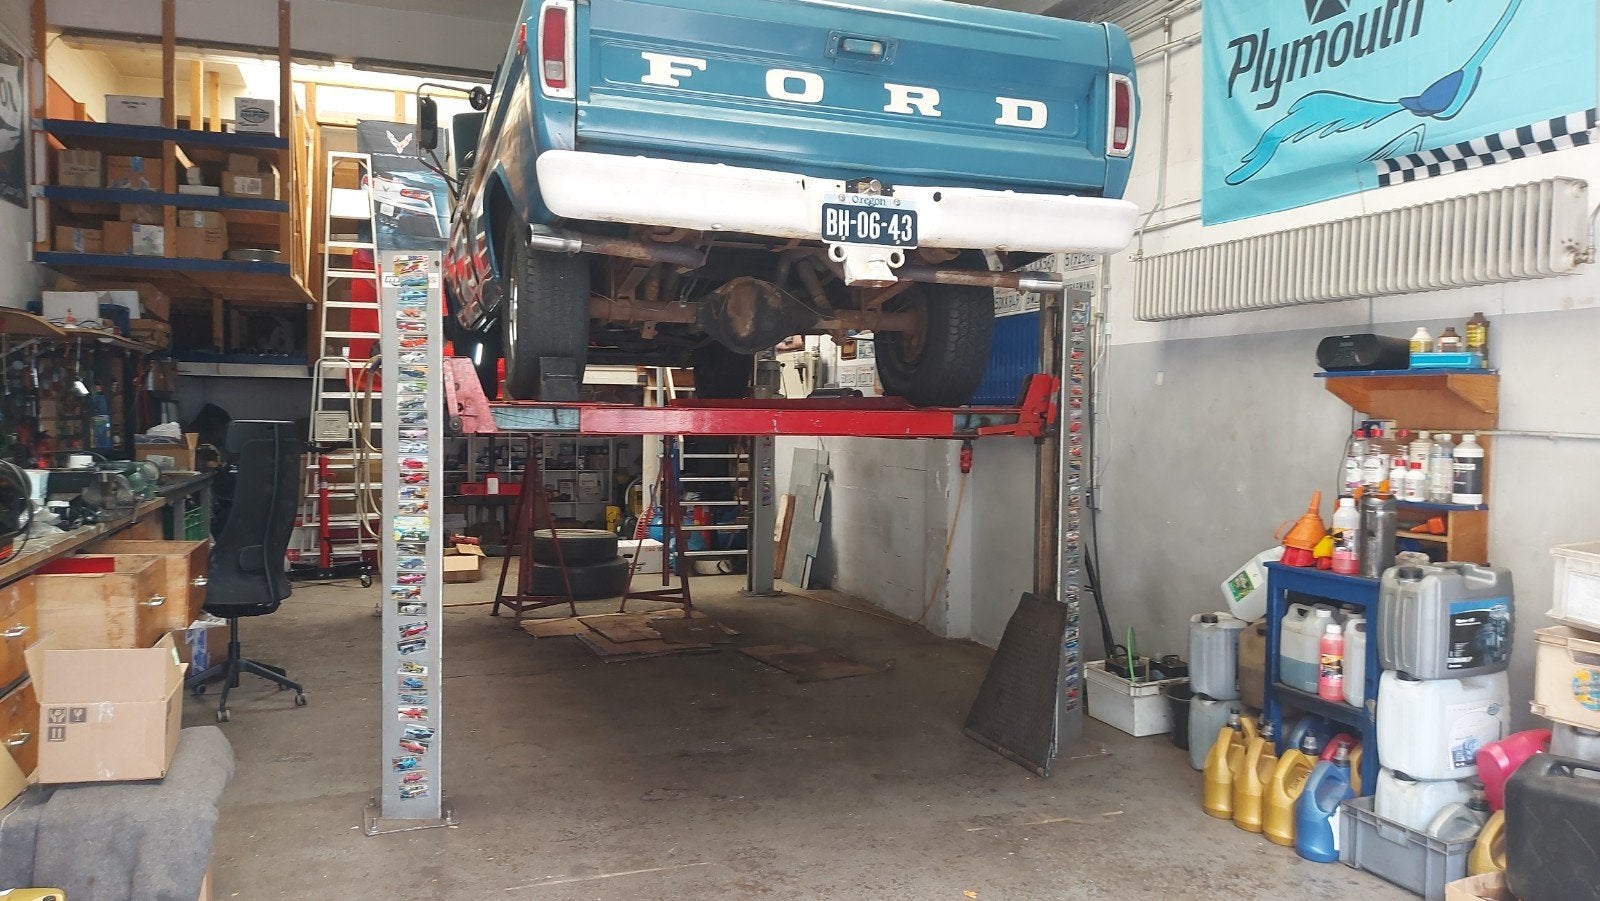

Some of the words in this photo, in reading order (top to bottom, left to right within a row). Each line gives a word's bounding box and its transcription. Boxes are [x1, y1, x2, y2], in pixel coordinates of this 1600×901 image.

[1227, 0, 1424, 111] Plymouth
[640, 51, 1049, 129] FORD
[826, 207, 913, 242] BH-06-43
[851, 195, 887, 207] Oregon
